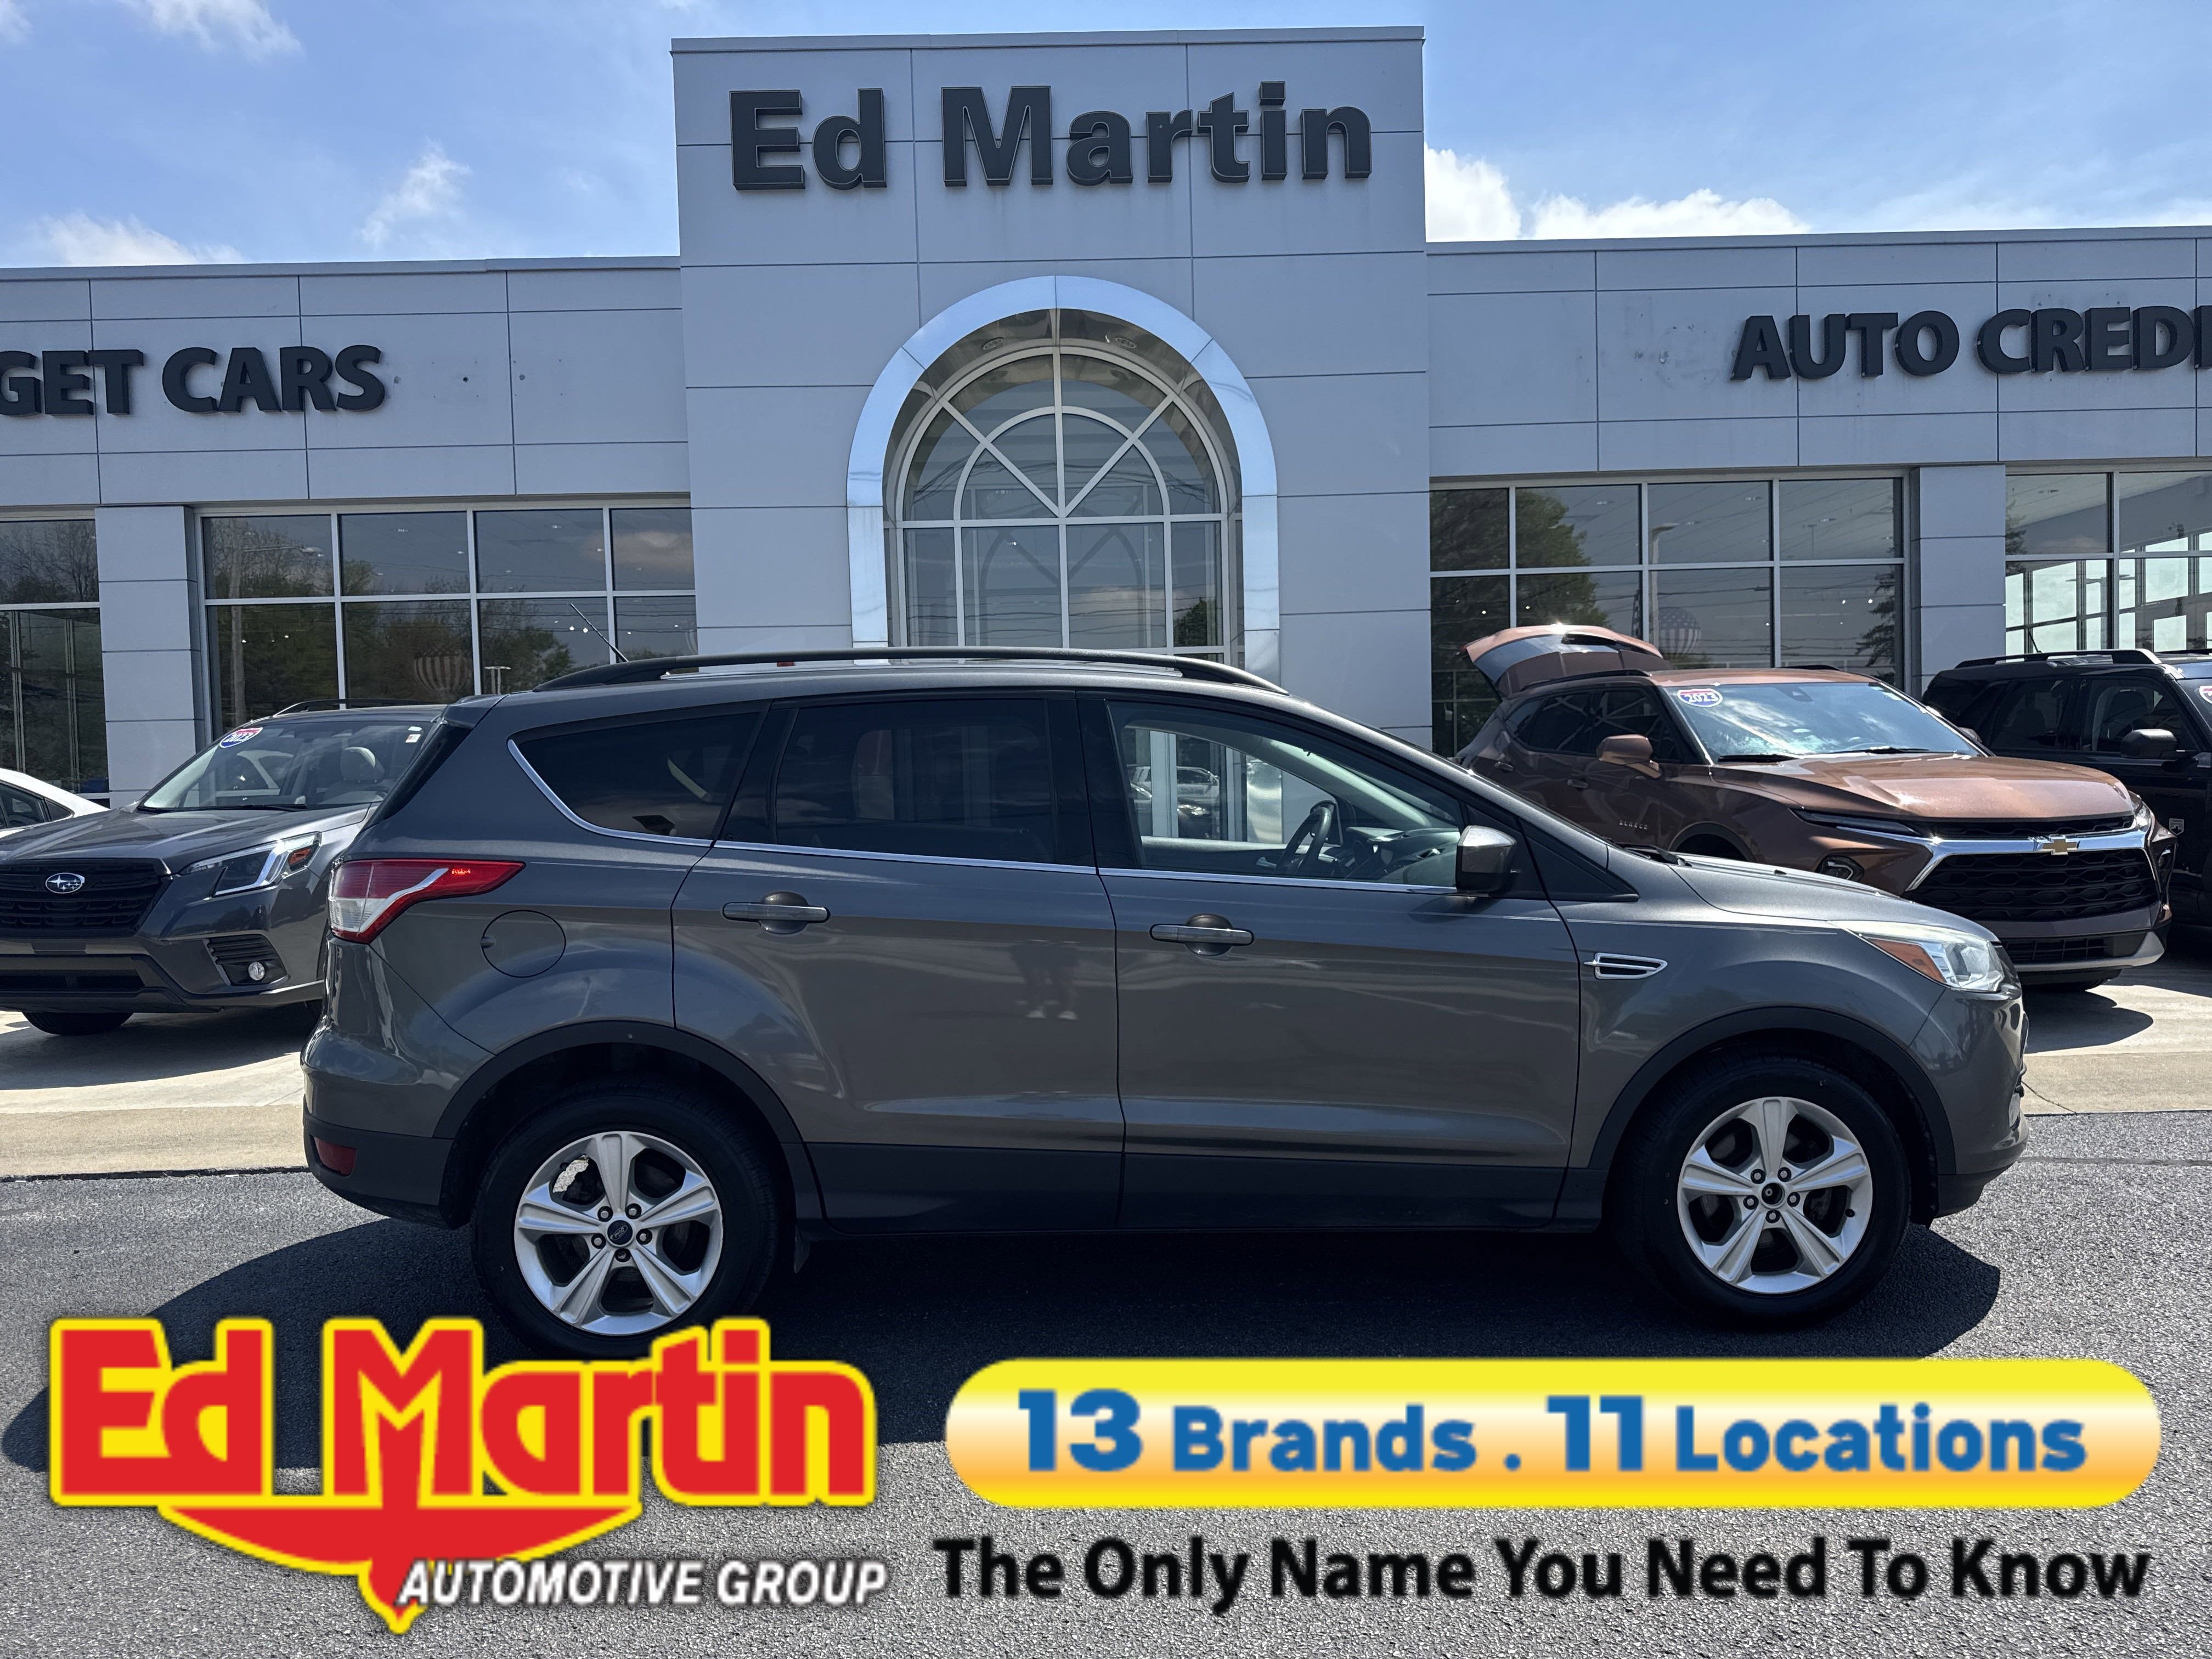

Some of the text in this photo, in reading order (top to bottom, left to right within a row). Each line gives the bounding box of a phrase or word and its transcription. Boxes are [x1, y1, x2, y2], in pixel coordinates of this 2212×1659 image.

[729, 81, 1372, 190] Ed Martin
[0, 345, 385, 416] GET CARS
[1730, 311, 1960, 380] AUTO
[1684, 693, 1719, 703] 2023
